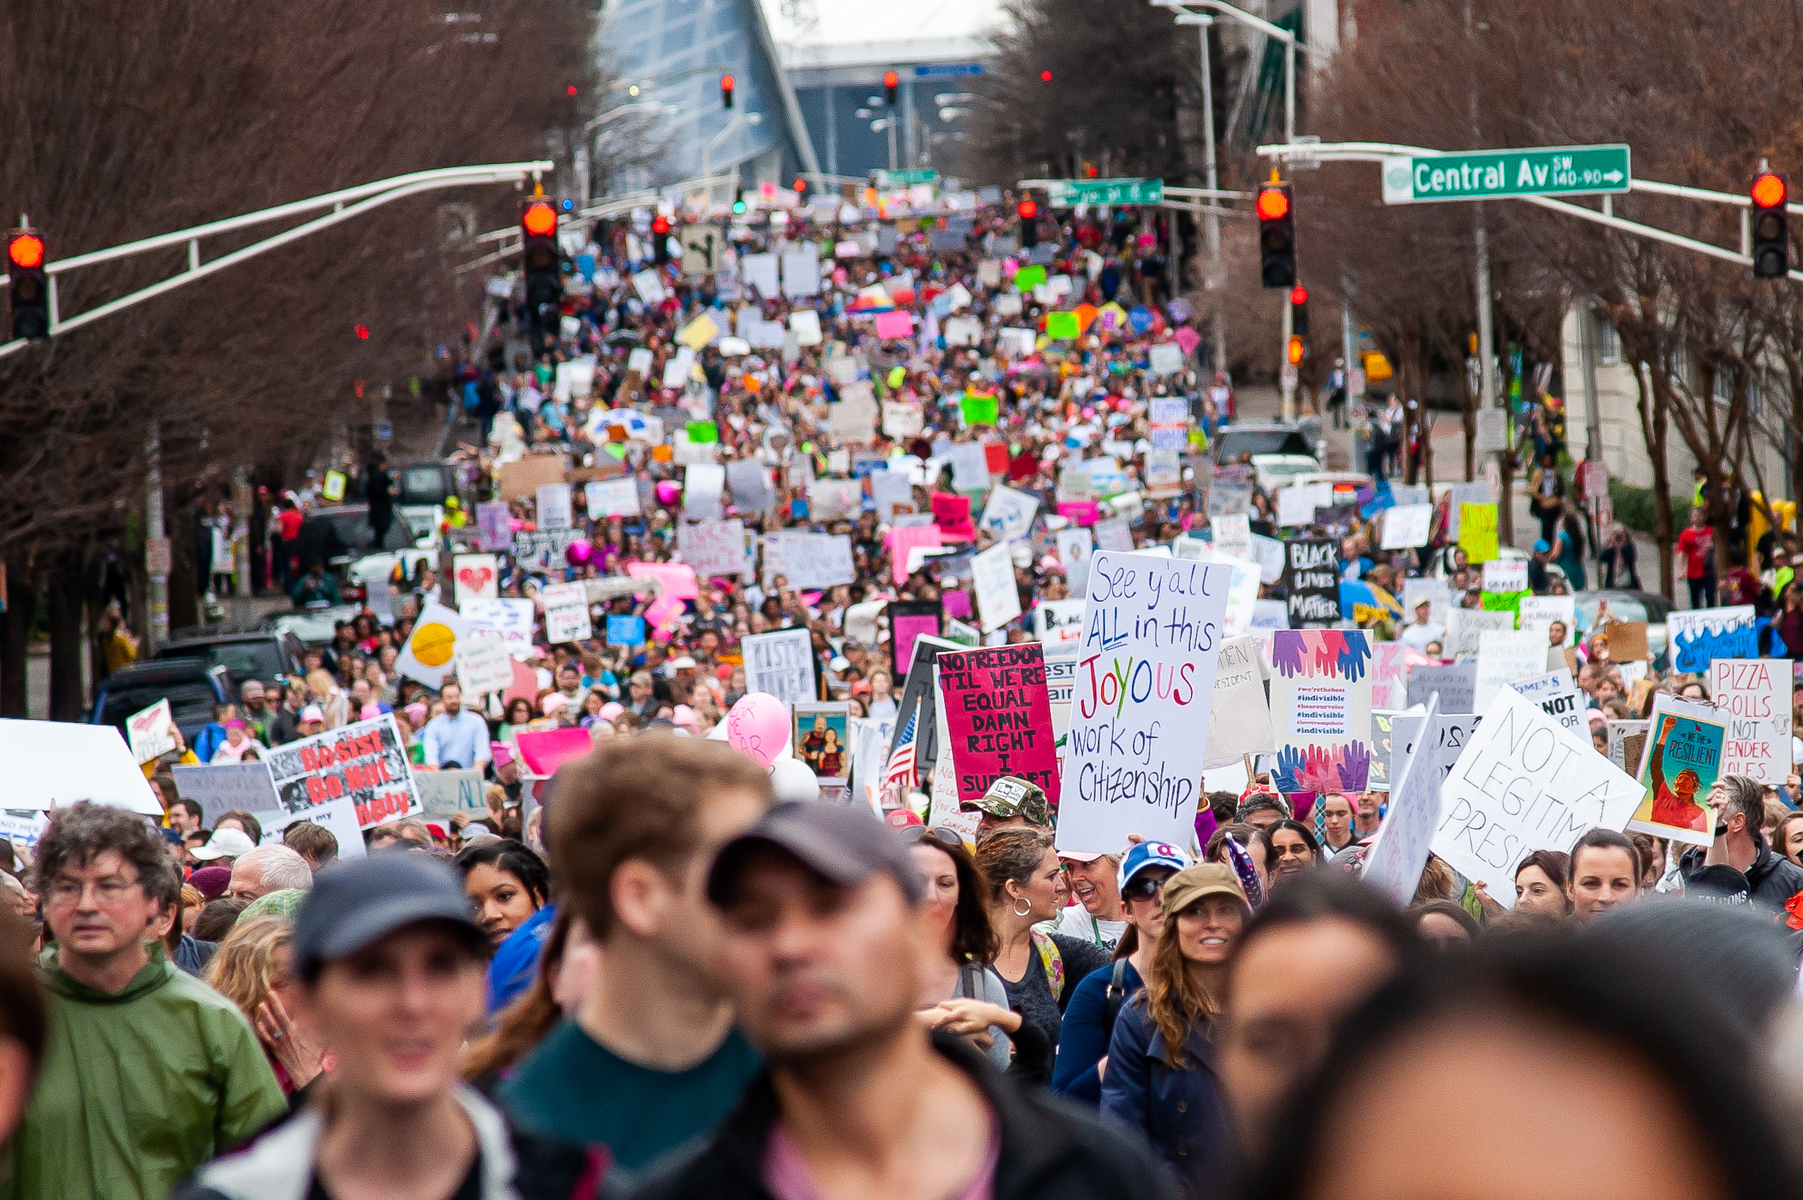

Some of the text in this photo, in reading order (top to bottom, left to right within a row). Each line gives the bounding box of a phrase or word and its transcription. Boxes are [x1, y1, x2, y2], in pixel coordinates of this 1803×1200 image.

[1414, 157, 1549, 193] Central Av
[1552, 155, 1573, 171] SW
[1552, 168, 1602, 186] 140-90
[1291, 542, 1340, 570] BLACK
[1092, 556, 1211, 610] See y'all
[1294, 571, 1334, 590] LIVES
[1289, 594, 1340, 619] MATTER
[1087, 606, 1215, 653] ALL in this
[937, 644, 1044, 672] NO FREEDOM
[940, 666, 1046, 691] TIL WE'RE
[1718, 663, 1772, 690] PIZZA
[963, 688, 1032, 712] EQUAL
[1542, 694, 1575, 715] NOT
[972, 711, 1029, 732] DAMN
[1561, 715, 1579, 728] OR
[1733, 720, 1760, 740] NOT
[967, 730, 1036, 753] RIGHT
[1072, 716, 1161, 765] work of
[1727, 741, 1772, 759] ENDER
[998, 754, 1013, 772] I
[1492, 707, 1581, 783] NOT
[1575, 780, 1609, 822] A
[1669, 740, 1717, 767] RESILIENT
[1079, 760, 1192, 819] Citizenship
[1463, 749, 1588, 852] LEGITIM
[1439, 797, 1535, 883] PRESI
